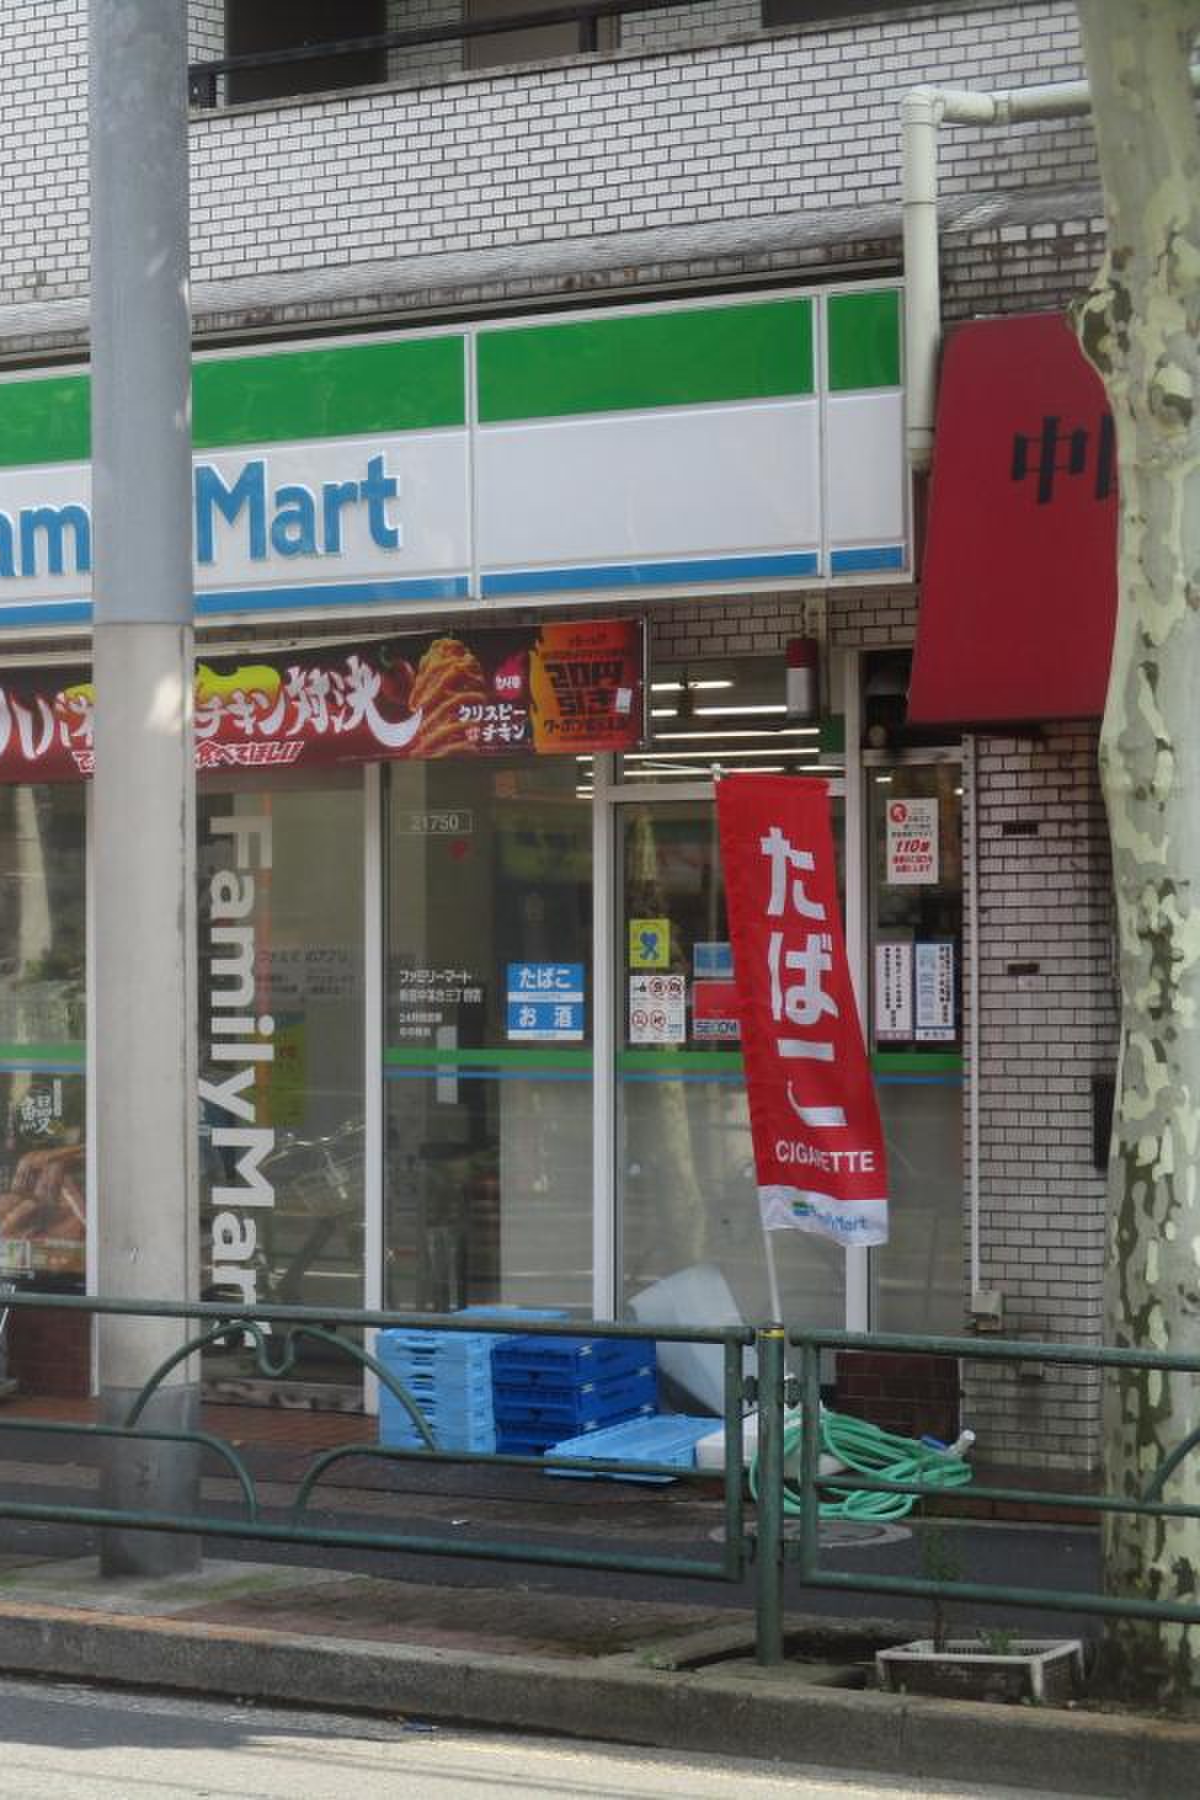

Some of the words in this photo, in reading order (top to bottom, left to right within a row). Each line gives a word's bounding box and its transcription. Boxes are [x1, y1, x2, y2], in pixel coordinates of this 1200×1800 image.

[1011, 414, 1119, 505] 中
[457, 704, 528, 722] クリスピー
[481, 723, 526, 743] チキン
[519, 966, 572, 989] たばこ
[760, 826, 849, 1128] たばこ
